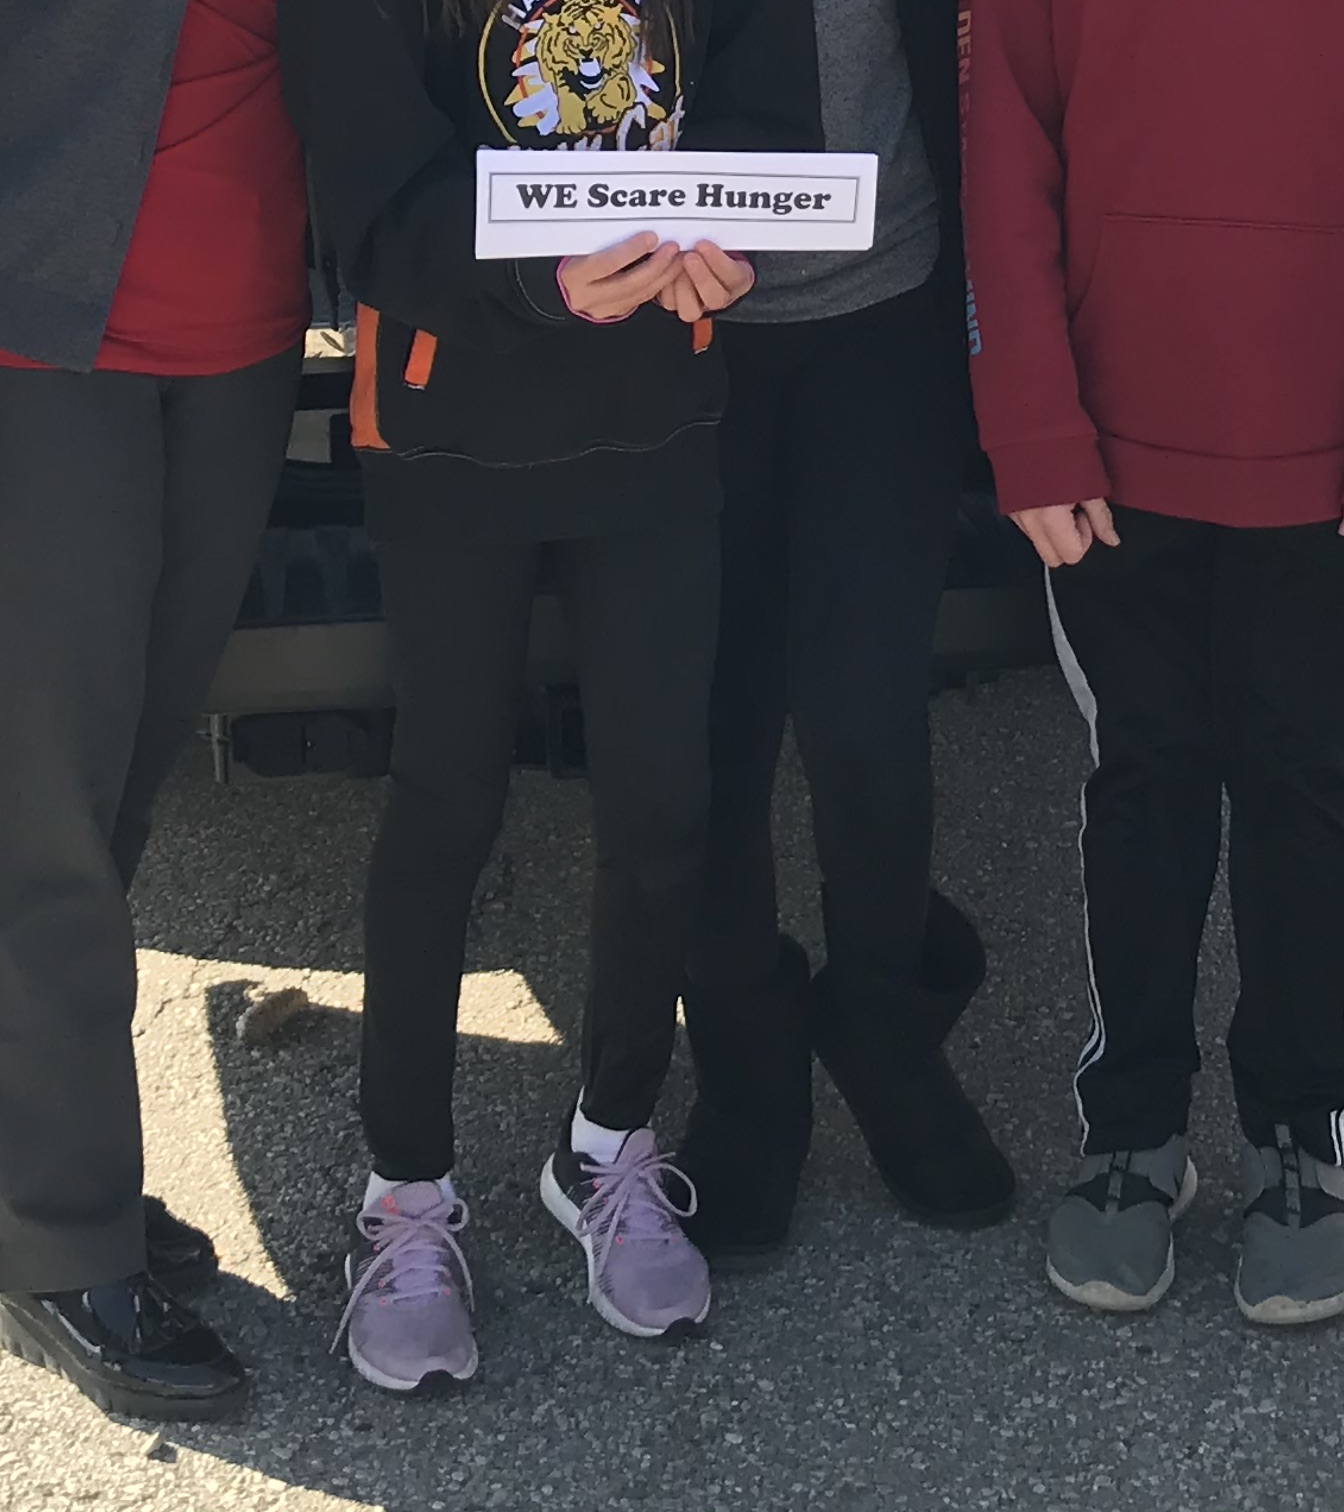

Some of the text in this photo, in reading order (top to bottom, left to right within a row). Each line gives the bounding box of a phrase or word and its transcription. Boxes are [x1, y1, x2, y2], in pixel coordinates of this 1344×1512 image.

[515, 182, 832, 215] WE Scare Hunger
